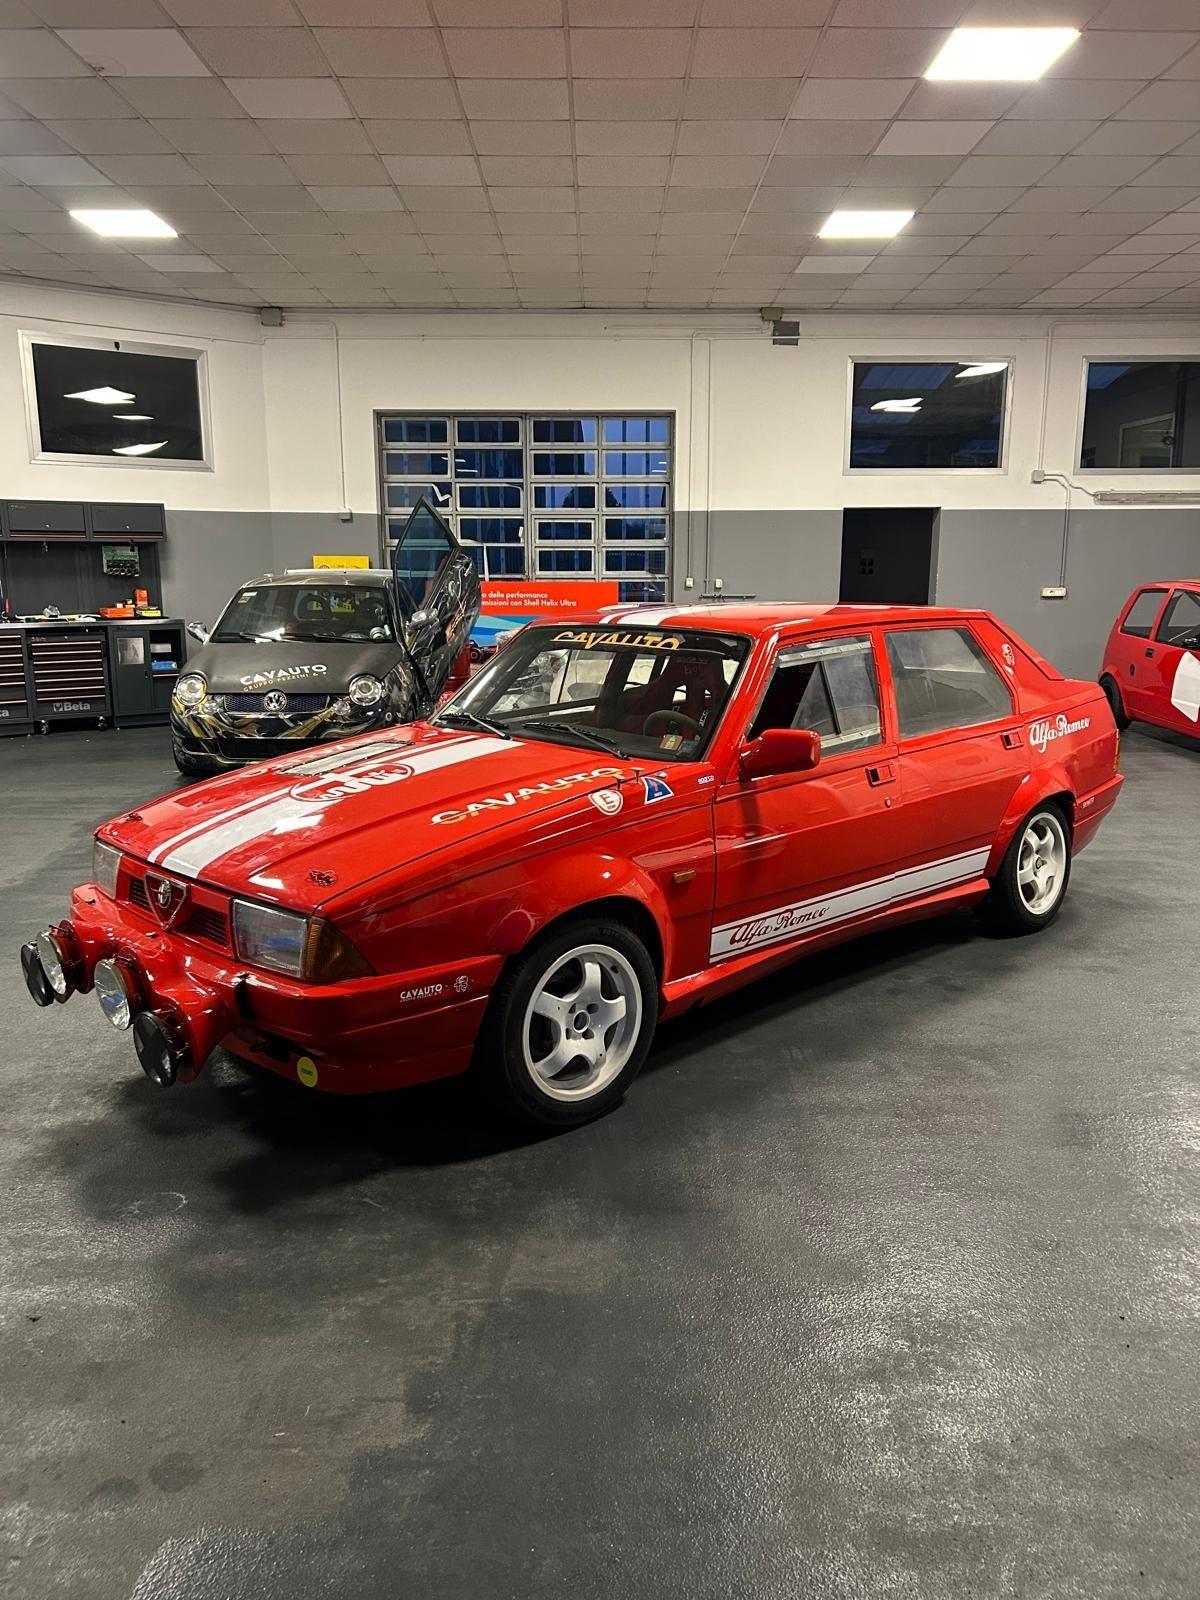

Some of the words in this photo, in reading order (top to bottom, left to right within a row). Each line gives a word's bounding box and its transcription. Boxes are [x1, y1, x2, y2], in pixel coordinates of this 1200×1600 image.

[488, 590, 504, 598] delle
[506, 591, 548, 600] performance
[523, 598, 539, 606] Shell
[541, 598, 558, 606] Helix
[559, 598, 577, 606] Ultra
[551, 631, 680, 650] CAVAUTO
[240, 664, 327, 685] CAVAUTO
[243, 680, 274, 692] GRUPPO
[63, 702, 91, 711] Beta
[1029, 719, 1057, 753] Alfa
[1056, 714, 1090, 738] Romeo
[430, 767, 623, 825] CAVAUTO
[730, 920, 772, 947] Alfa
[774, 908, 830, 932] Romeo
[400, 983, 443, 999] CAVAUTO
